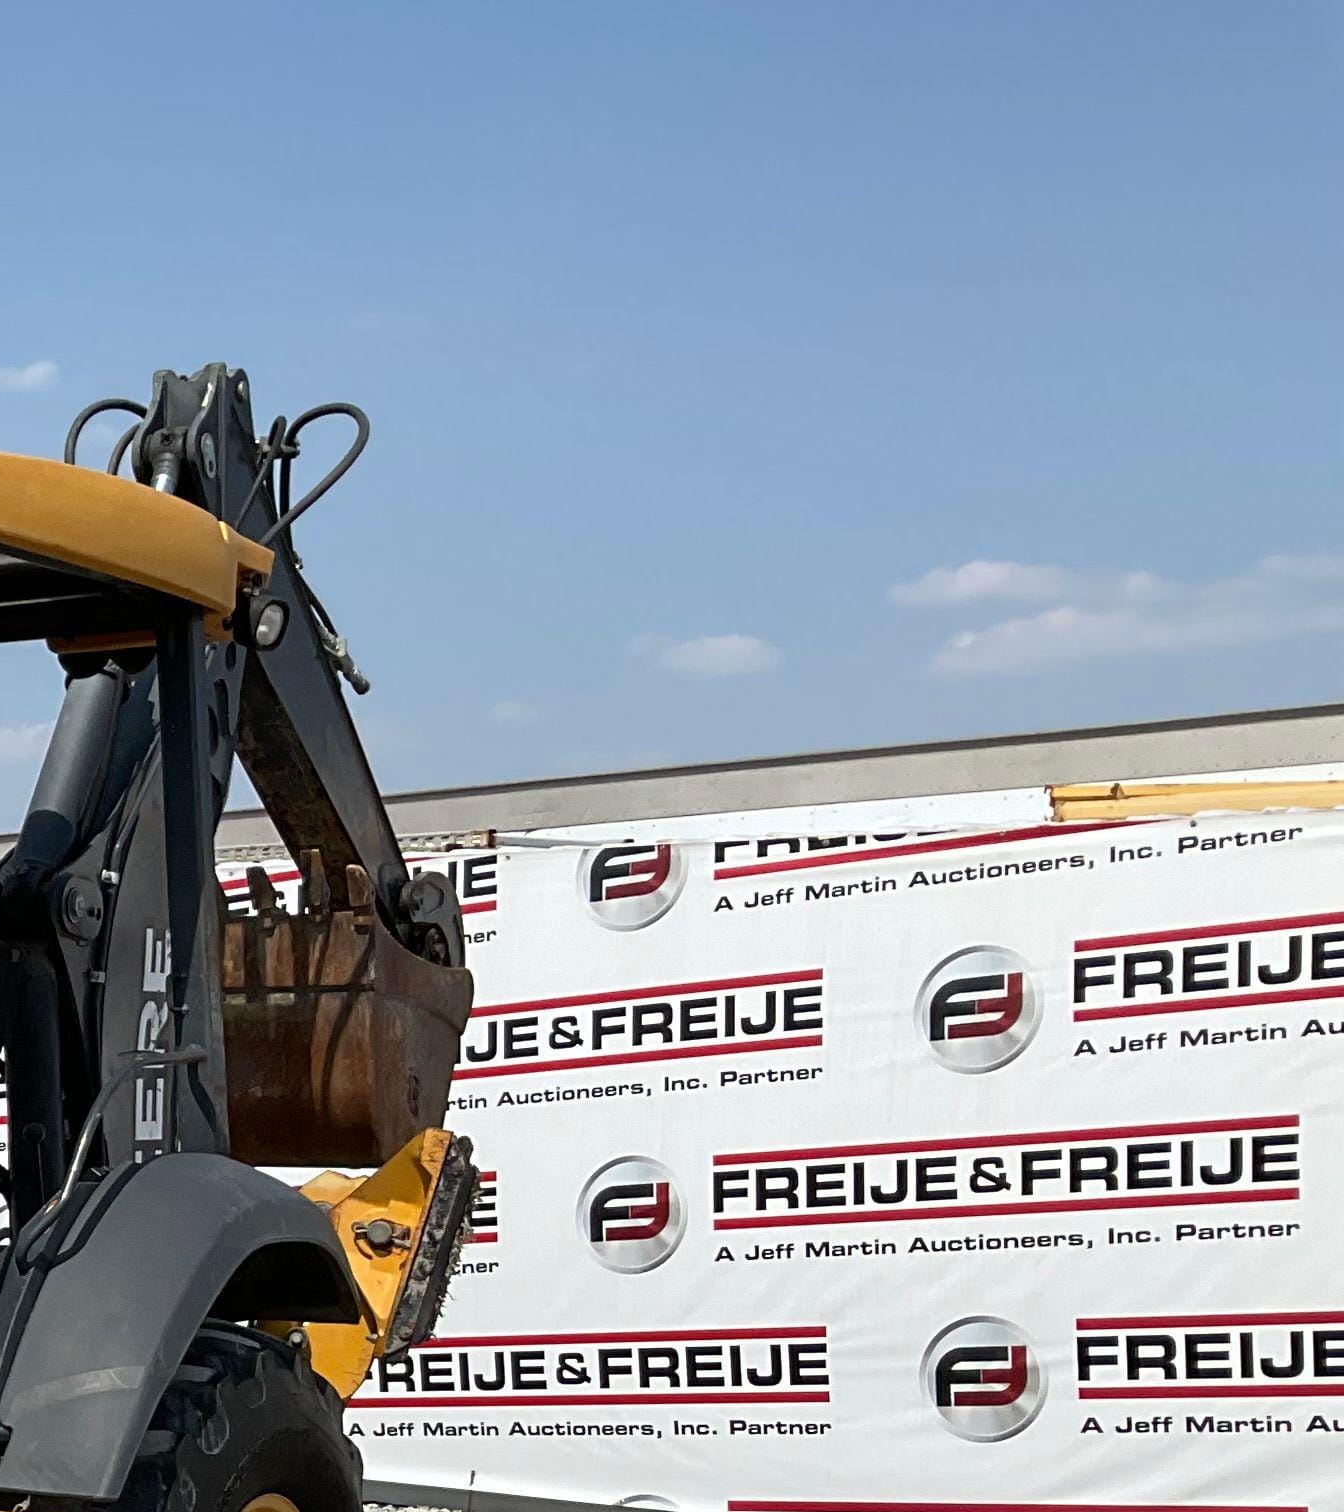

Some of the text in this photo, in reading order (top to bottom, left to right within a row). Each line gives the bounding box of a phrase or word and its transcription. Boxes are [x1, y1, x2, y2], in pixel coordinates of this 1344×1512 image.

[714, 826, 1303, 912] A Jeff Martin Auctioneers, Inc. Partner
[135, 928, 172, 1164] ERE
[1074, 1039, 1097, 1057] A
[1109, 1032, 1168, 1054] Jeff
[1180, 1023, 1287, 1048] Martin
[447, 1066, 823, 1111] rtin Auctioneers, Inc. Partner
[714, 1223, 1301, 1262] A Jeff Martin Auctioneers, Inc. Partner
[349, 1419, 832, 1439] A Jeff Martin Auctioneers, Inc. Partner
[1080, 1417, 1104, 1434] A
[1115, 1416, 1172, 1434] Jeff
[1186, 1414, 1292, 1434] Martin
